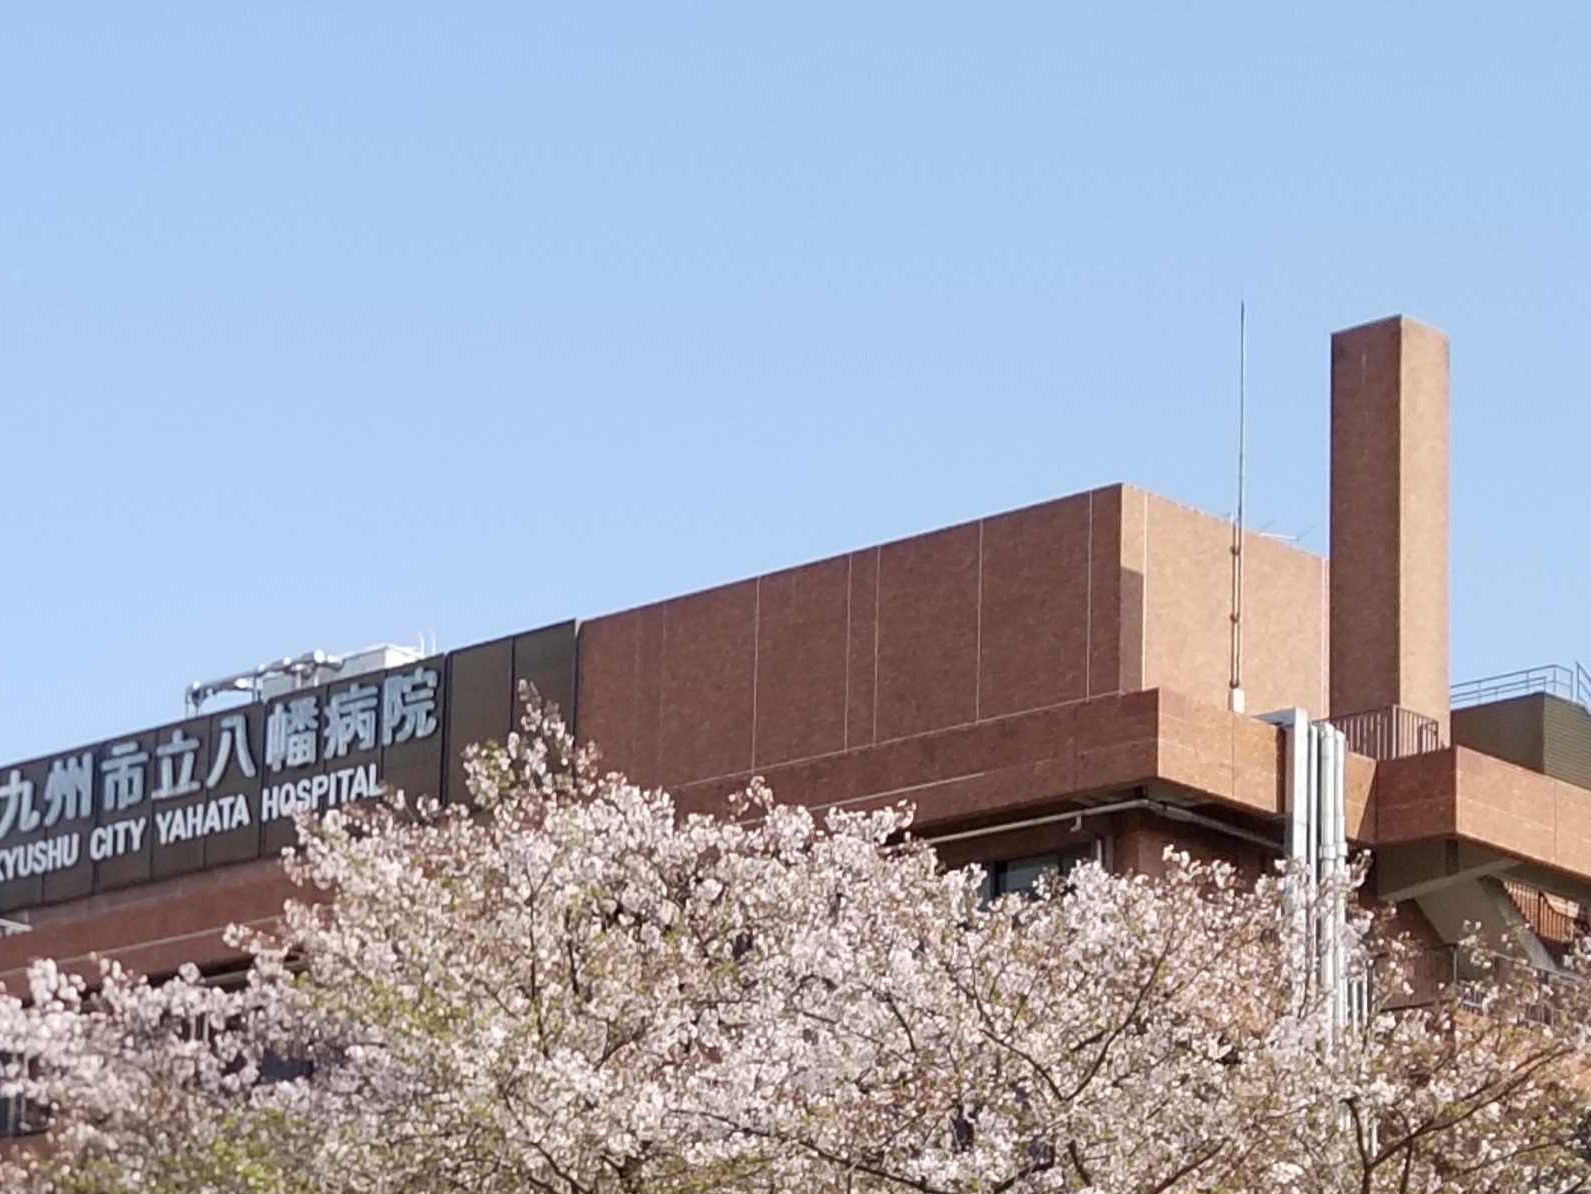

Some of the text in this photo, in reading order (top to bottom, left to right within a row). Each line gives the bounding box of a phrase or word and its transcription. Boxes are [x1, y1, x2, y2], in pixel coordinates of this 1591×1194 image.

[89, 816, 147, 862] CITY
[156, 794, 251, 846] YAHATA
[261, 763, 385, 822] HOSPITAL
